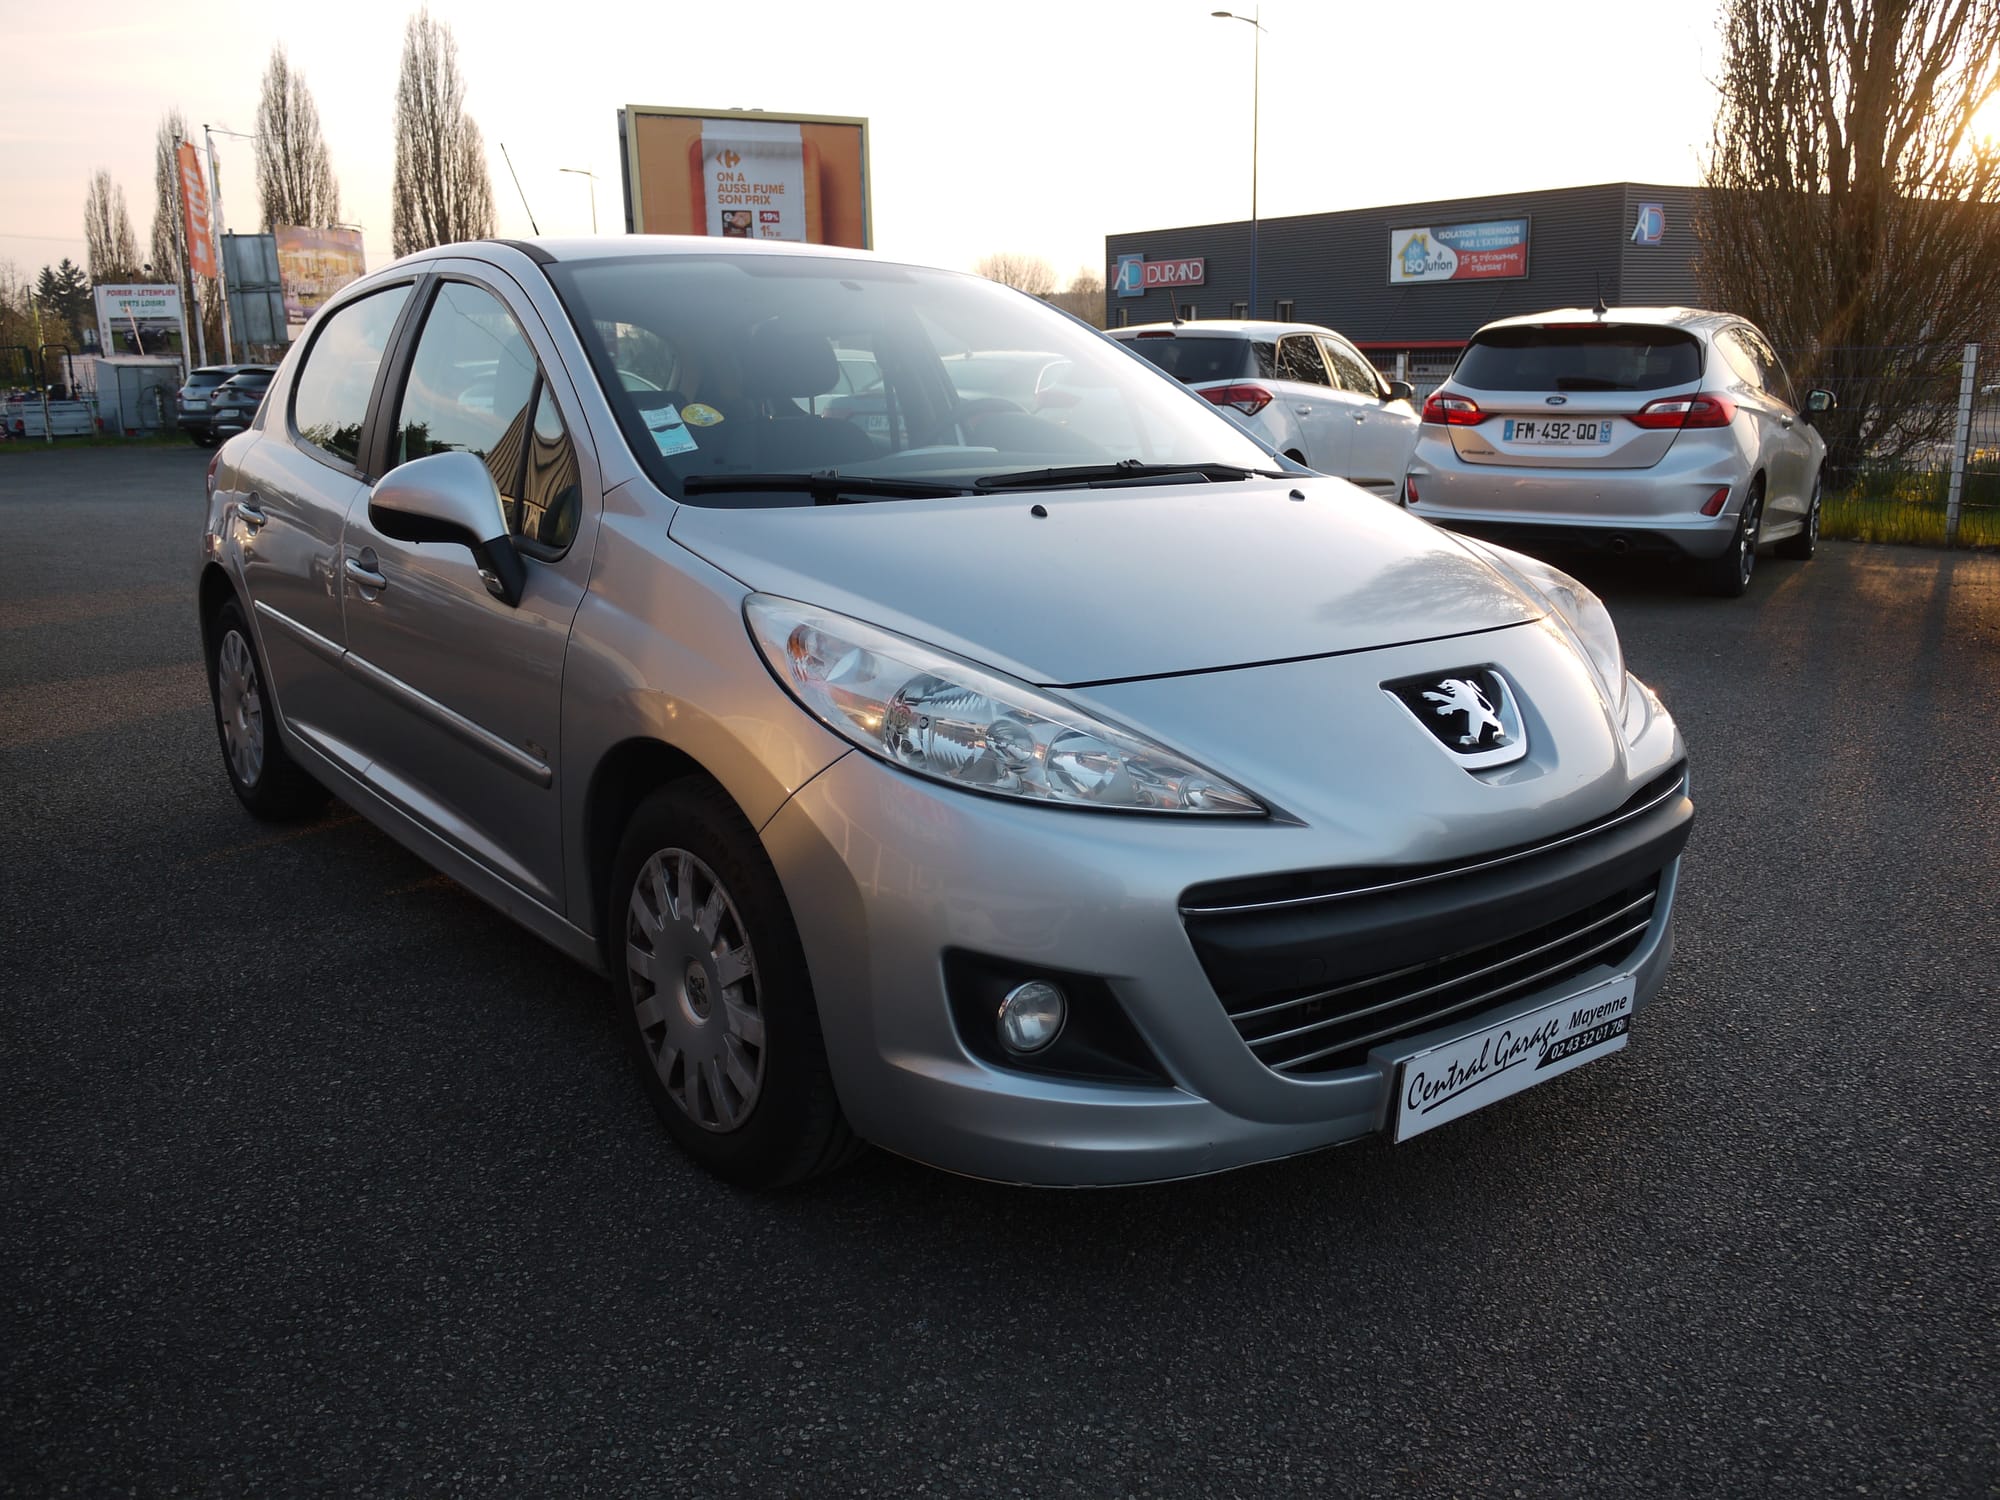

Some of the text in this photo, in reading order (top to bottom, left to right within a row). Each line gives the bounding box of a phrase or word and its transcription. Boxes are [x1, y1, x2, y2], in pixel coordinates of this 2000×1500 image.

[717, 172, 745, 182] ON A
[717, 182, 785, 195] AUSSI FUMÉ
[718, 195, 771, 206] SON PRIX
[1438, 229, 1477, 240] ISOLATION
[1113, 259, 1203, 291] AD DURAND
[1515, 422, 1598, 440] FM-492-QQ
[1550, 1042, 1566, 1060] 02
[1566, 1036, 1580, 1054] 43
[1580, 1031, 1596, 1048] 32
[1595, 1024, 1610, 1042] 01
[1407, 996, 1628, 1111] Central Garage Mayenne
